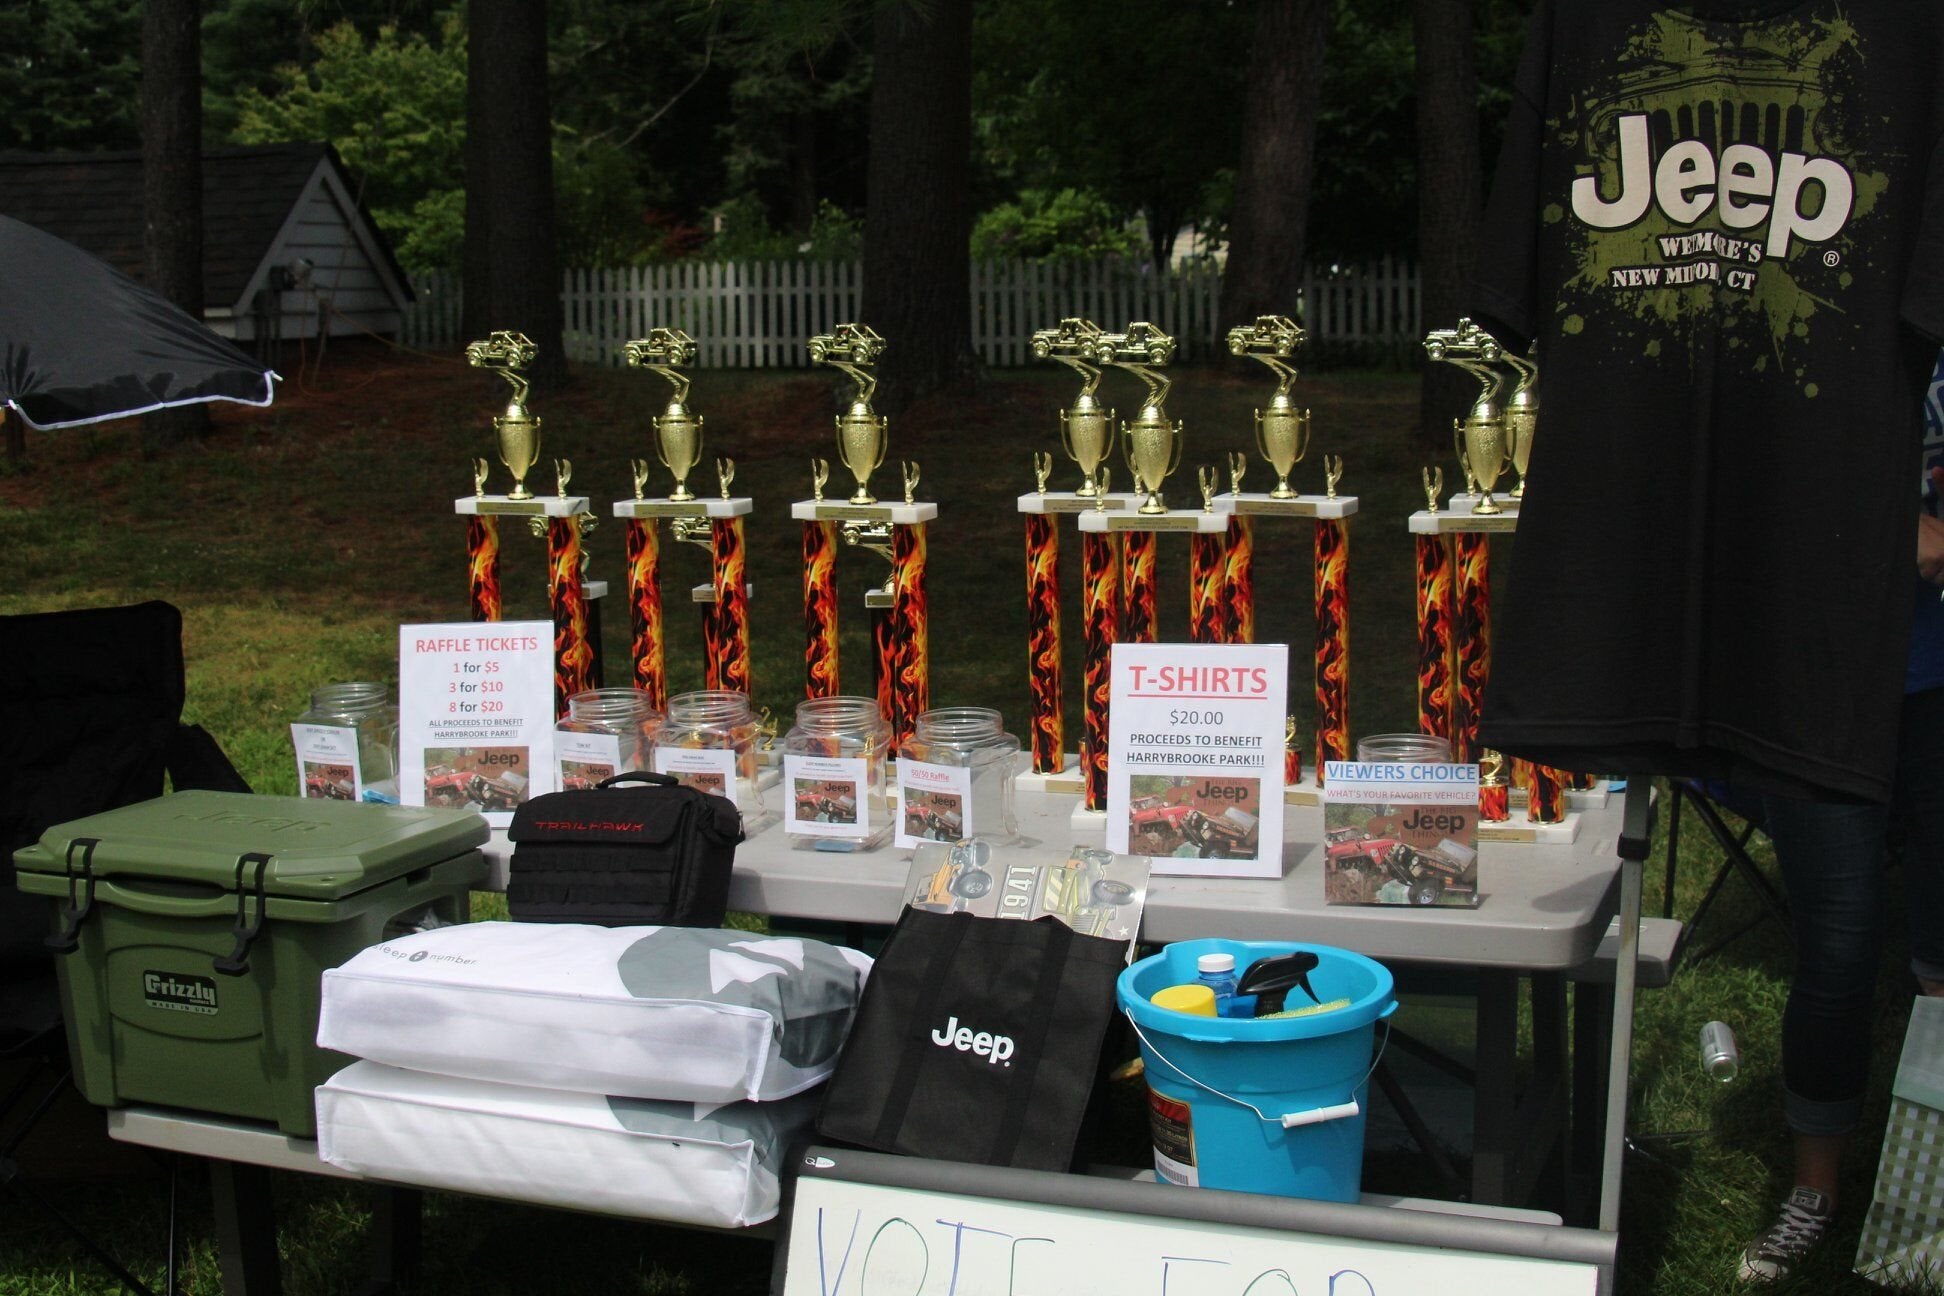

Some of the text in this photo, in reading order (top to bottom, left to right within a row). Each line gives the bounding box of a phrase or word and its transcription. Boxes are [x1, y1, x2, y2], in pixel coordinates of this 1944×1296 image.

[1571, 115, 1853, 257] Jeep
[1611, 268, 1661, 288] NEW
[1727, 270, 1756, 291] CT
[416, 637, 538, 653] RAFFLE TICKETS
[453, 661, 500, 674] 1 for $5
[1128, 665, 1268, 693] T-SHIRTS
[449, 681, 503, 694] 3 for $10
[449, 701, 503, 714] 8 for $20
[429, 718, 524, 728] ALL PROCEEDS TO BENEFIT
[1170, 709, 1224, 726] $20.00
[434, 729, 518, 739] HARRYBROOKE PARK!!!
[1130, 734, 1263, 747] PROCEEDS TO BENEFIT
[478, 750, 520, 767] Jeep
[1127, 752, 1265, 765] HARRYBROOKE PARK!!!
[327, 766, 349, 777] Jeep
[586, 765, 610, 778] Jeep
[911, 769, 950, 782] 50/50 Raffle
[1328, 763, 1476, 781] VIEWERS CHOICE
[695, 775, 720, 786] Jeep
[824, 783, 850, 794] Jeep
[1196, 780, 1249, 804] Jeep
[1327, 789, 1476, 800] WHAT'S YOUR FAVORITE VEHICLE?
[931, 795, 956, 808] Jeep
[535, 821, 646, 832] TRAILHAWK
[1403, 808, 1466, 834] Jeep
[1001, 866, 1036, 919] 1941
[429, 953, 477, 965] number
[145, 973, 216, 1006] Grizzly
[931, 1017, 1014, 1064] Jeep
